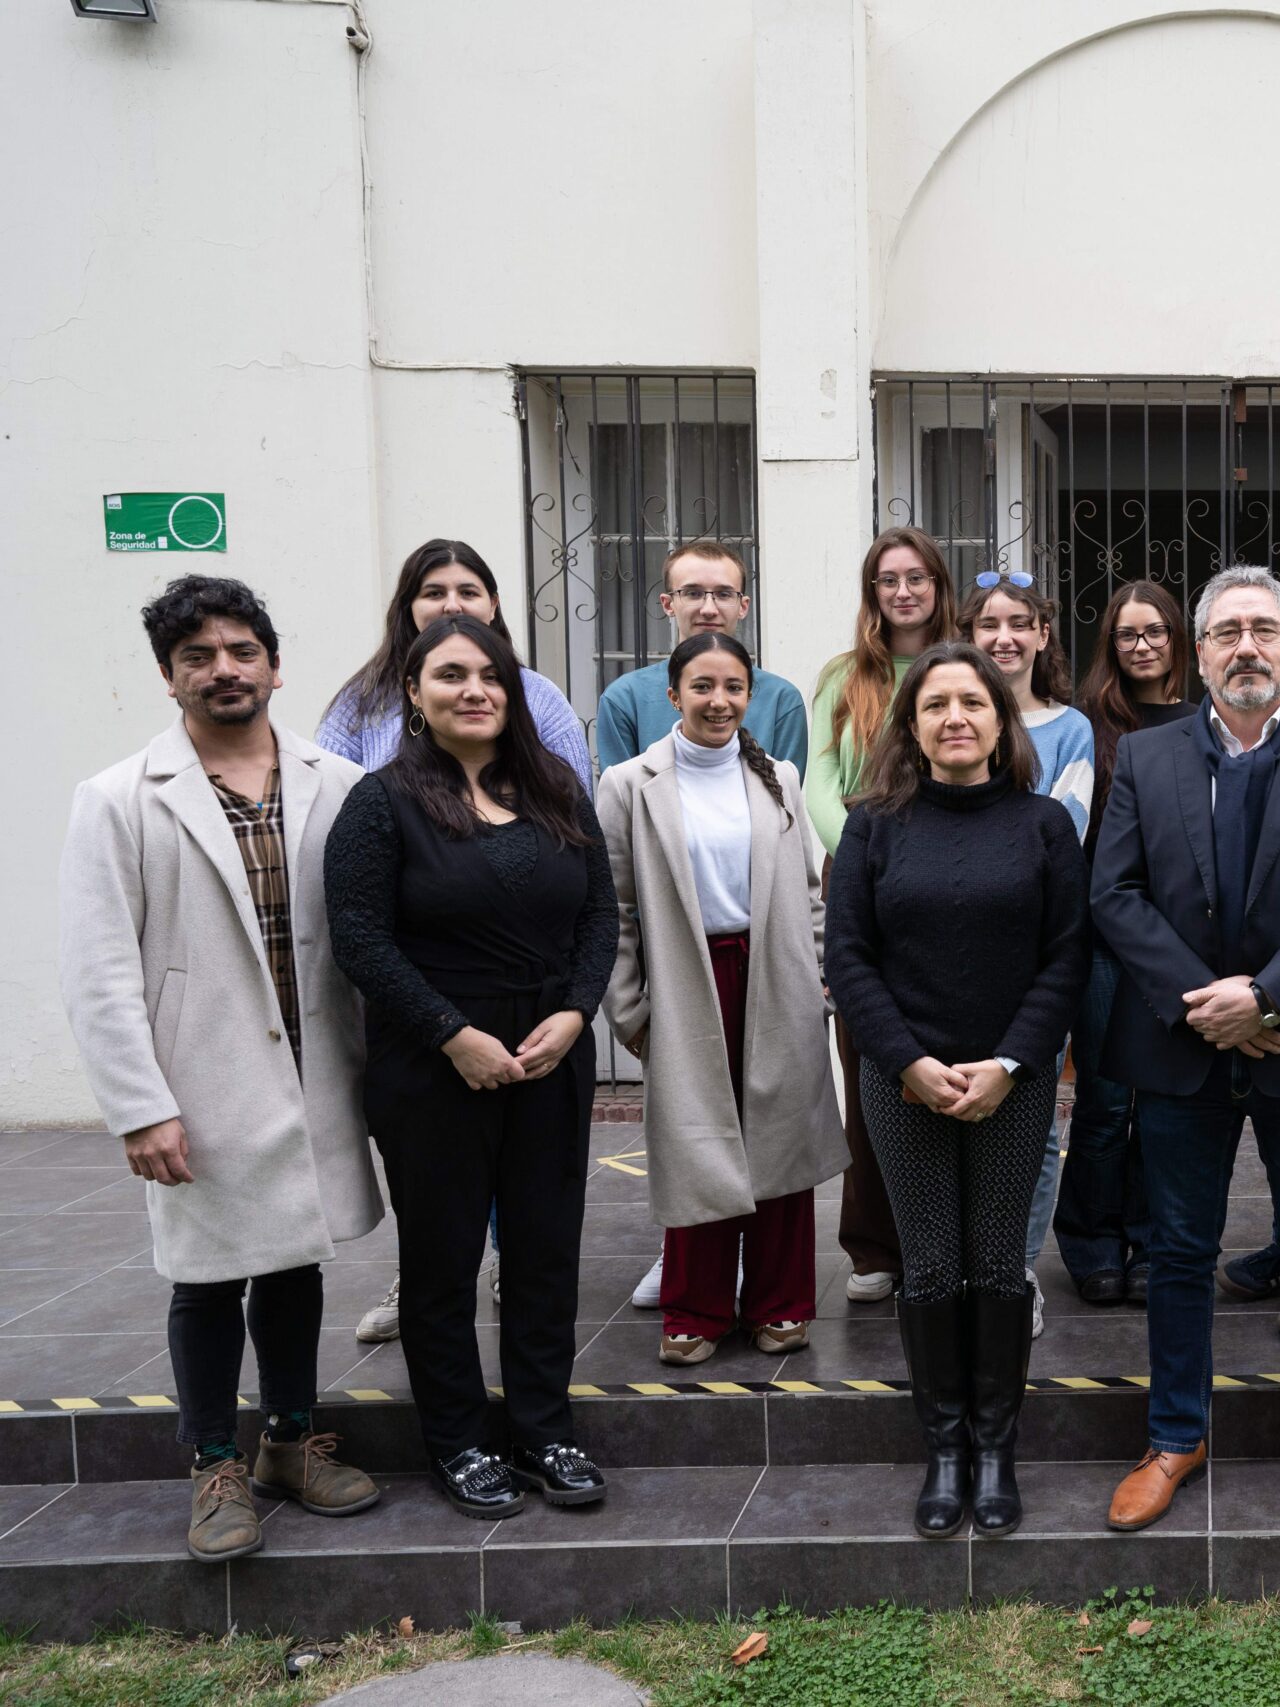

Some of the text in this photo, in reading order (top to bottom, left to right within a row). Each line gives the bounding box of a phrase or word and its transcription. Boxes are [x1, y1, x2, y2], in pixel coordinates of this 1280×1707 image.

[110, 532, 146, 540] Zona de
[110, 542, 156, 550] Seguridad
